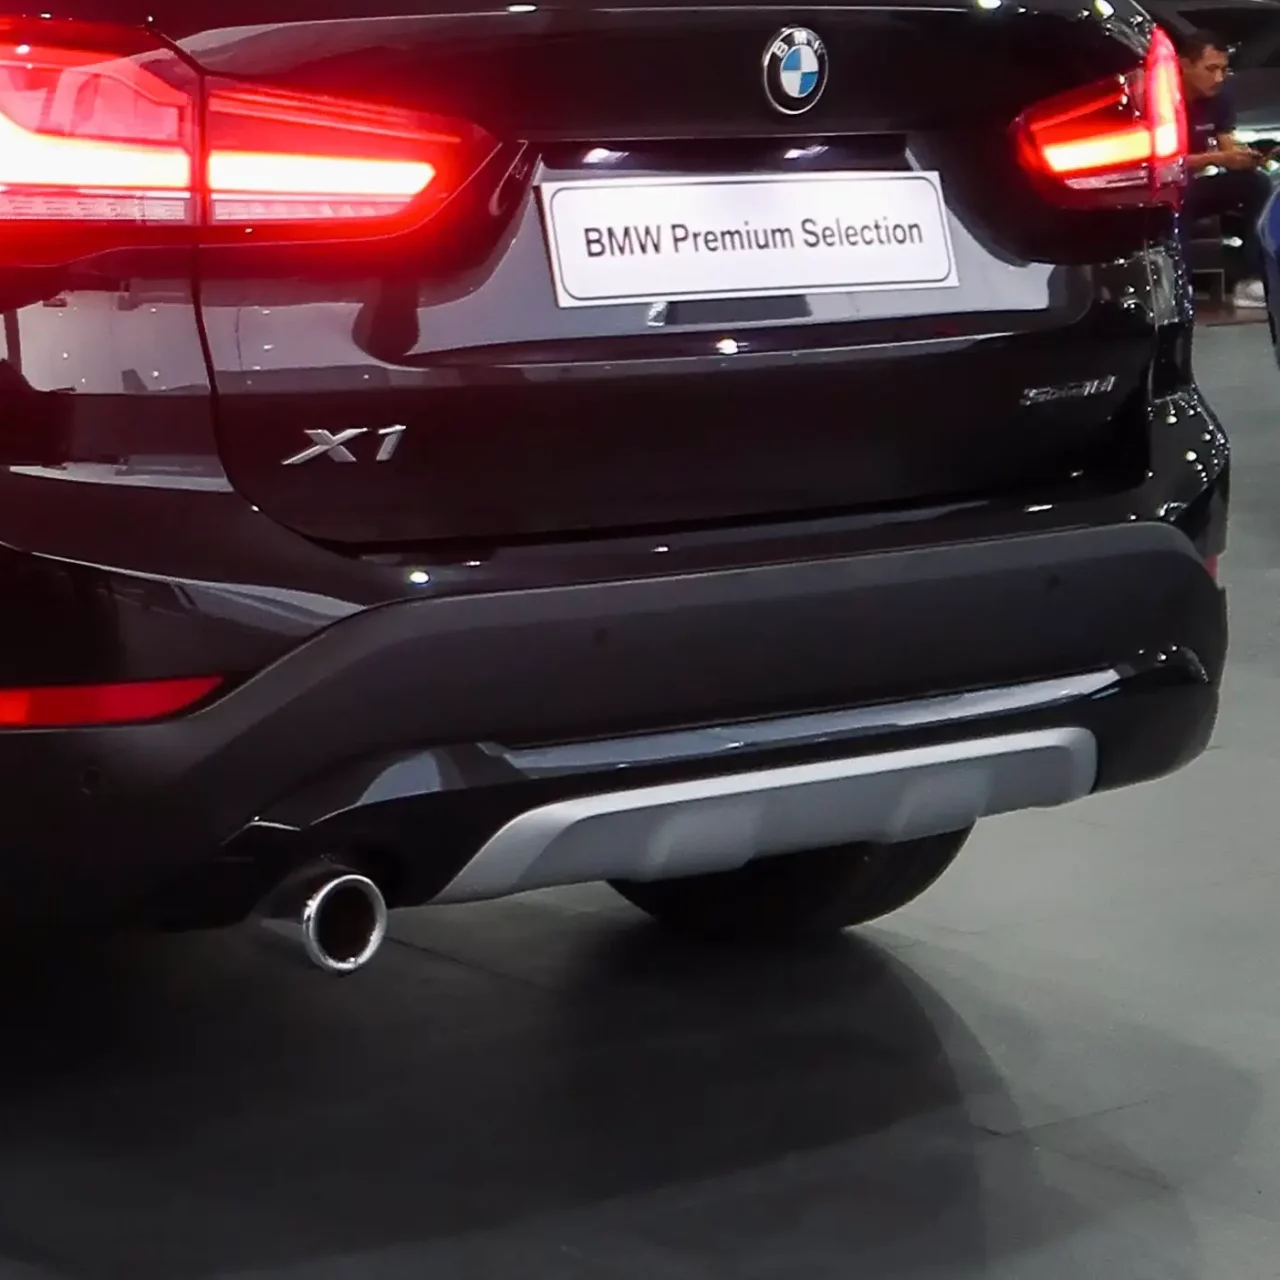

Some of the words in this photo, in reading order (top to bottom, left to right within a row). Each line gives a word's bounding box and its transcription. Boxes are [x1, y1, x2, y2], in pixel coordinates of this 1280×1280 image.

[773, 30, 826, 58] BMW
[583, 225, 662, 258] BMW
[671, 221, 795, 253] Premium
[801, 217, 924, 248] Selection
[281, 424, 407, 465] X1
